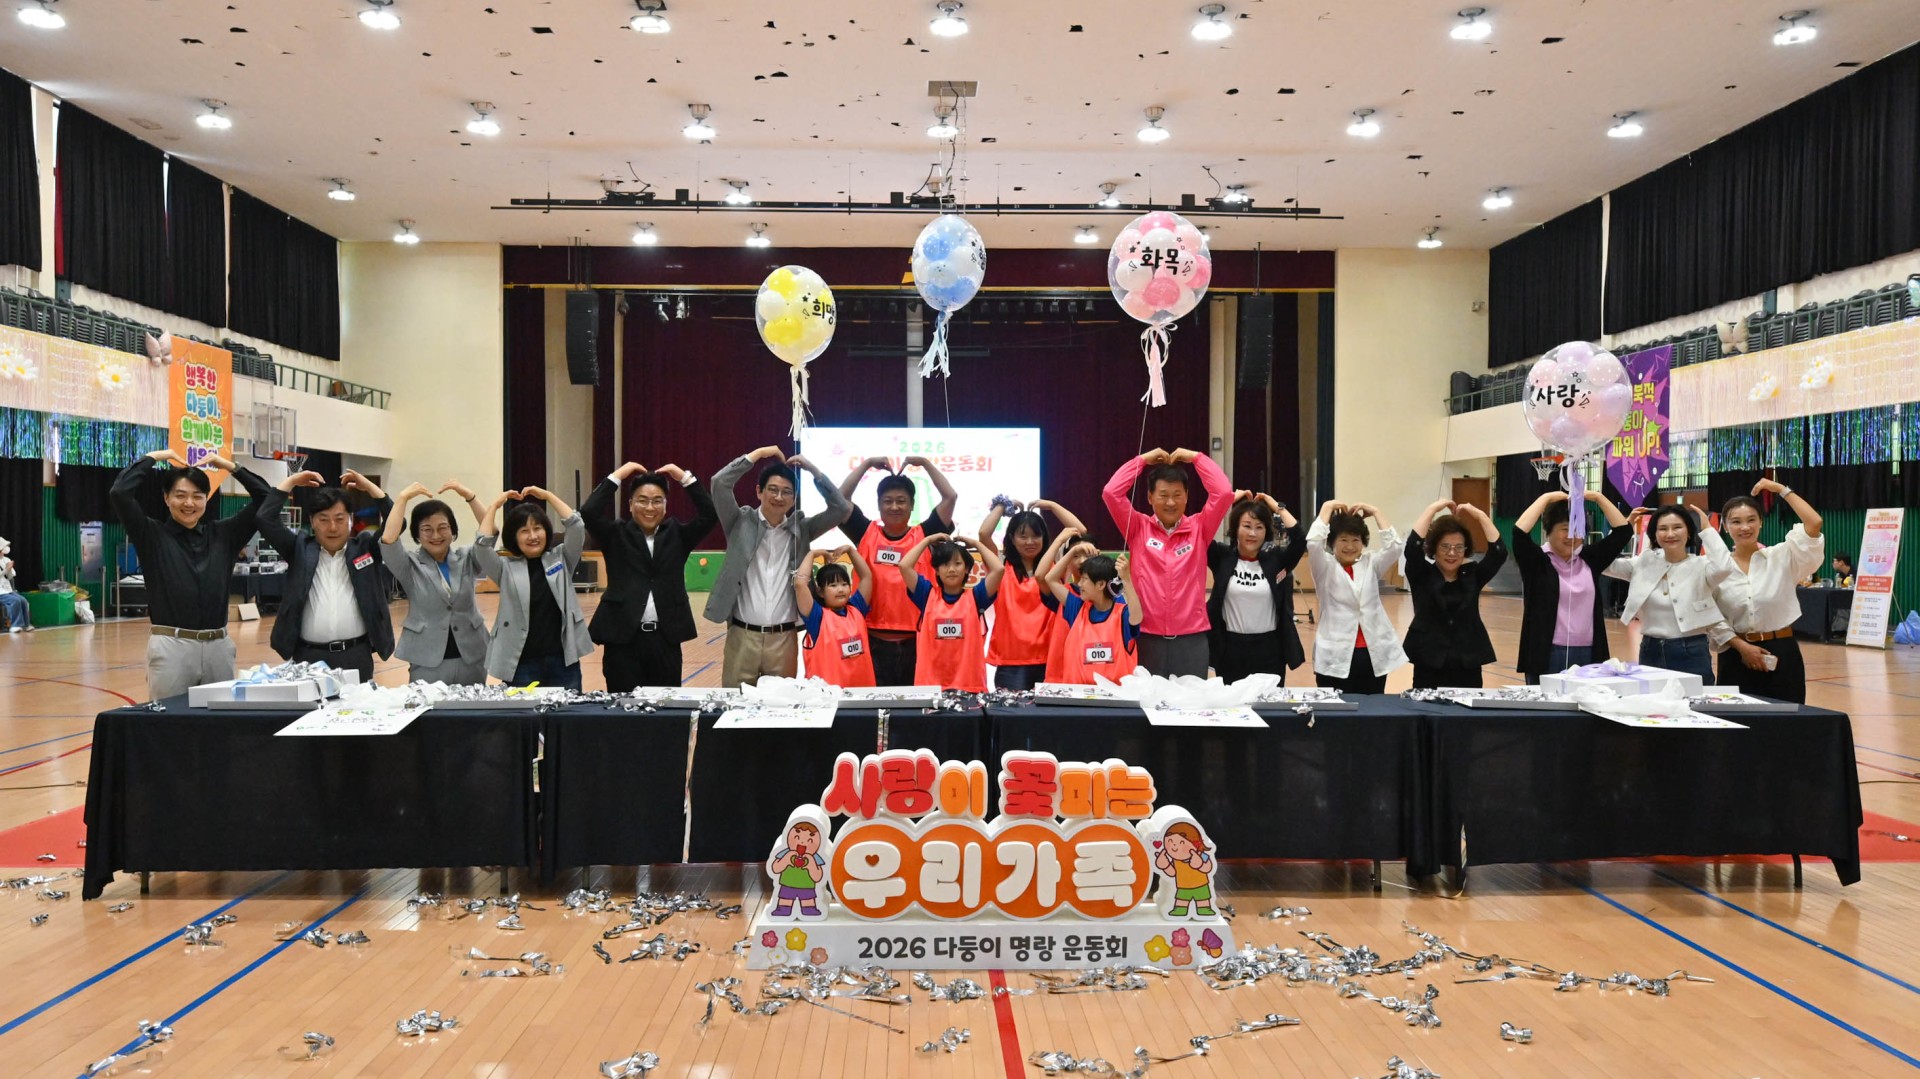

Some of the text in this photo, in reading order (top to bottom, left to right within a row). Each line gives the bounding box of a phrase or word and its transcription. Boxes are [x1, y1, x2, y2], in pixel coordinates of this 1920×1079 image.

[1140, 246, 1180, 276] 화목
[186, 364, 217, 391] 행복한
[1536, 384, 1581, 408] 사랑
[182, 417, 223, 446] 함께하는
[1612, 416, 1661, 458] 파워 UP!
[899, 441, 946, 454] 2026
[881, 552, 896, 562] 010
[942, 625, 957, 635] 010
[847, 642, 859, 653] 010
[1091, 650, 1106, 660] 010
[823, 757, 1155, 820] 사랑이 꽃피는
[841, 840, 1138, 909] 우리가족
[857, 935, 1129, 961] 2026 다둥이 명랑 운동회
